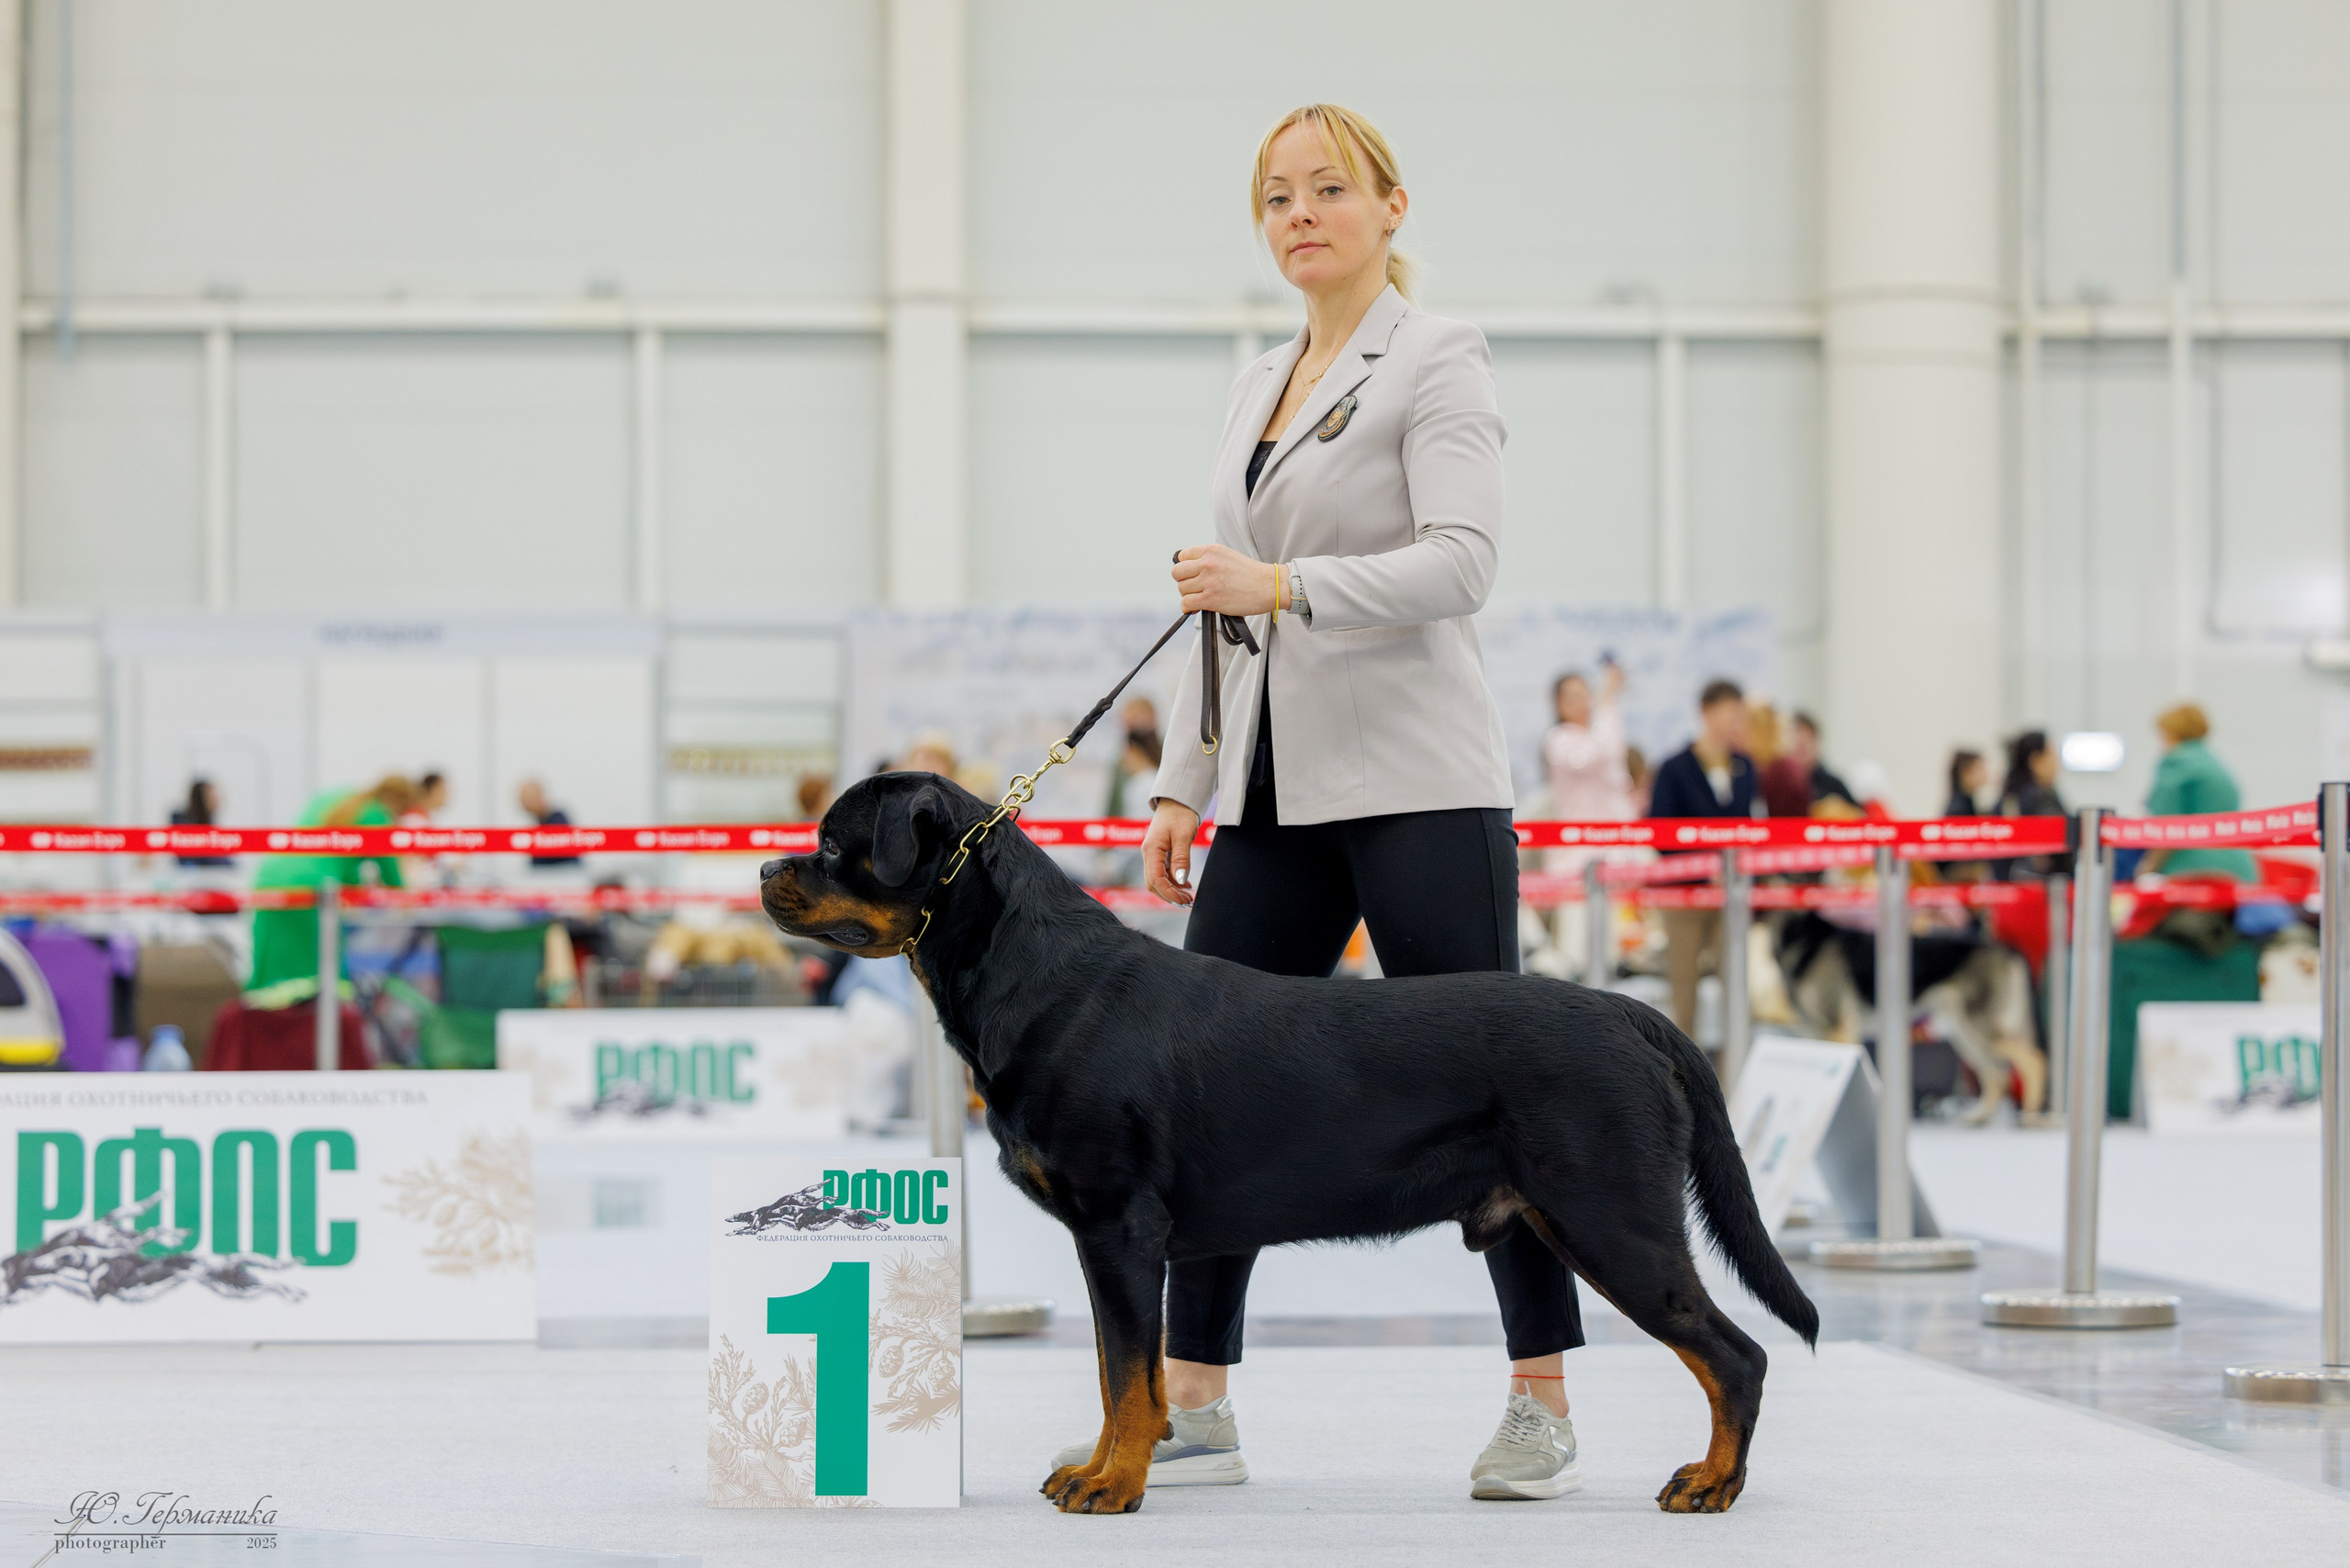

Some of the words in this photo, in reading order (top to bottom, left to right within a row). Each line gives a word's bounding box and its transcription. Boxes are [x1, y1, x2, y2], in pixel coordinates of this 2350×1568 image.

[68, 1089, 233, 1107] ОХОТНИЧЬЕГО
[237, 1088, 429, 1107] СОБАКОВОДСТВА
[595, 1042, 755, 1103] РФОС
[17, 1127, 358, 1266] РФОС
[823, 1169, 948, 1224] РФОС
[756, 1234, 808, 1242] ФЕДЕРАЦИЯ
[767, 1261, 869, 1495] 1
